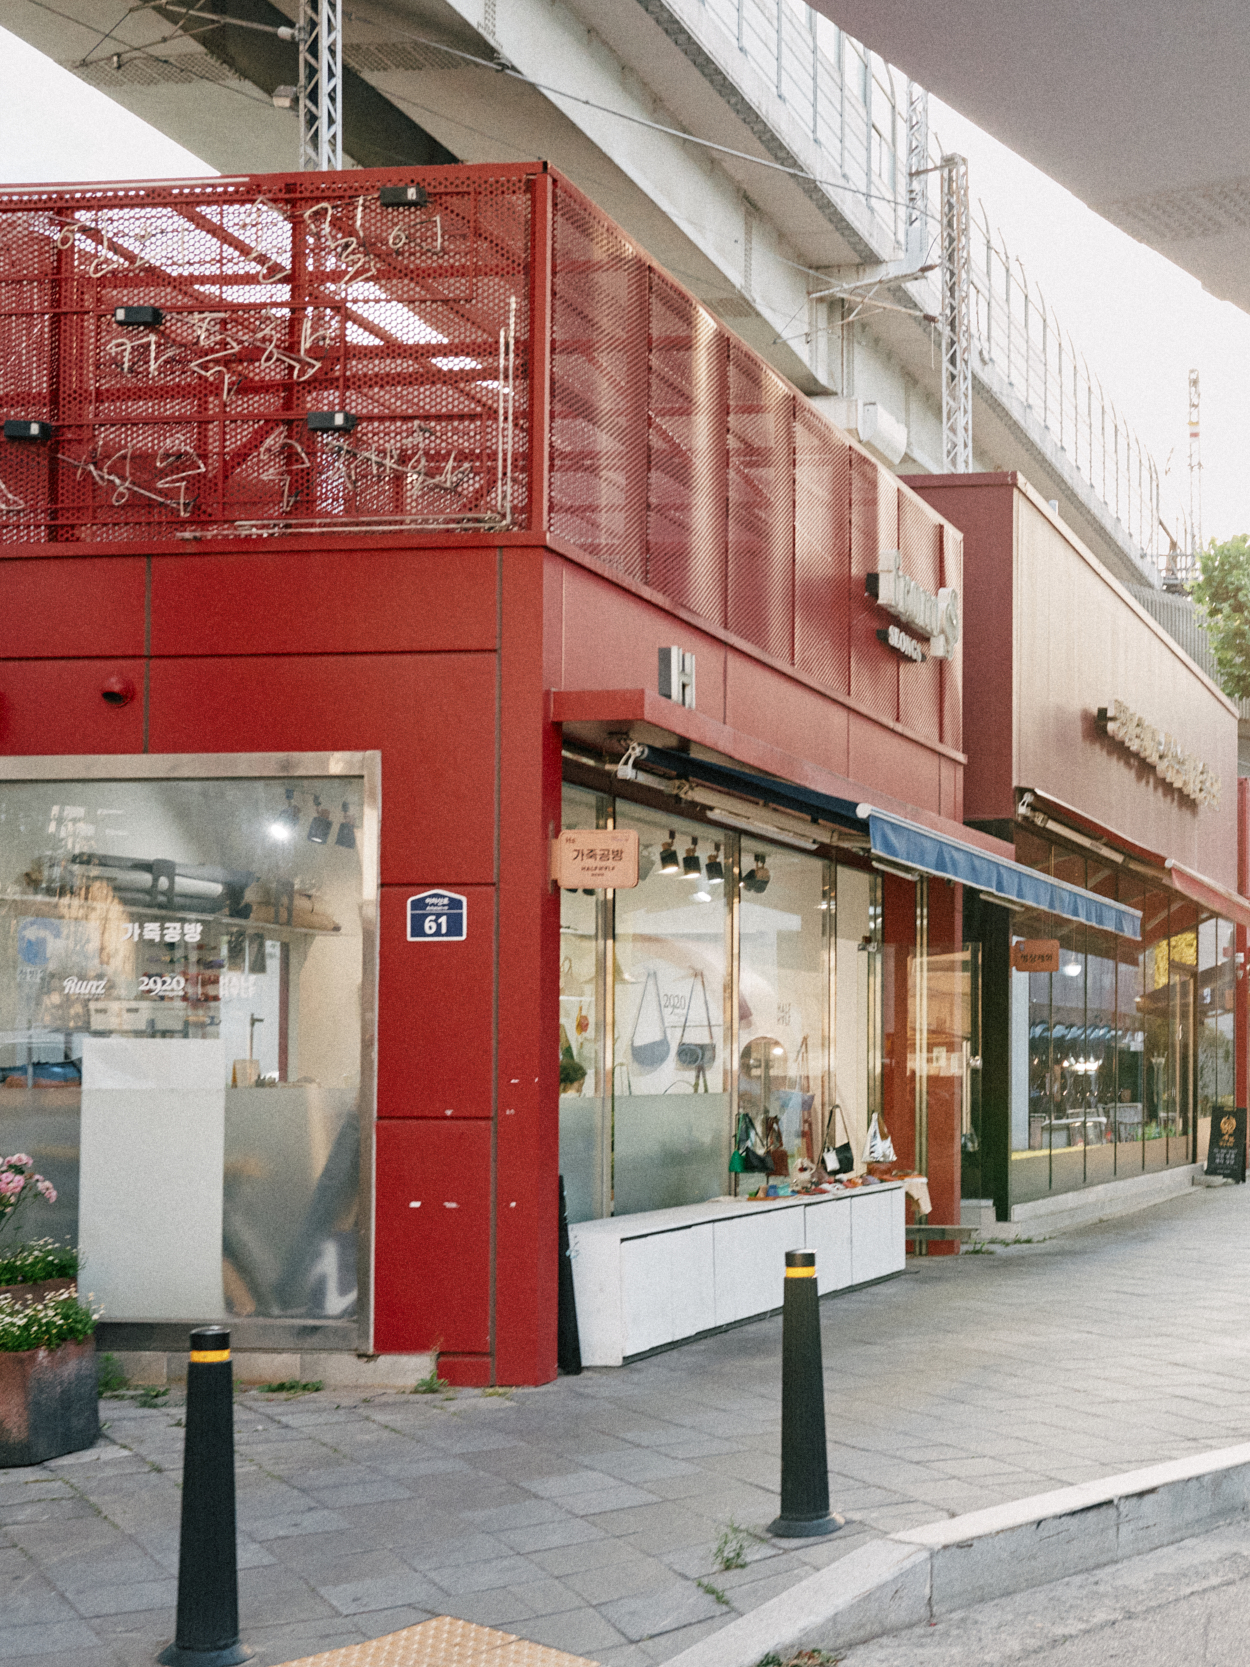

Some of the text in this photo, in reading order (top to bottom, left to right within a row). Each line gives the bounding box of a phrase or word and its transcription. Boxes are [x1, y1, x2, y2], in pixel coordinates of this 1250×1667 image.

[670, 645, 696, 710] H
[572, 848, 624, 862] 가죽공방
[121, 921, 203, 943] 가죽공방
[423, 914, 448, 935] 61
[62, 974, 108, 995] Runz
[138, 975, 186, 996] 2920
[663, 993, 687, 1015] 2920
